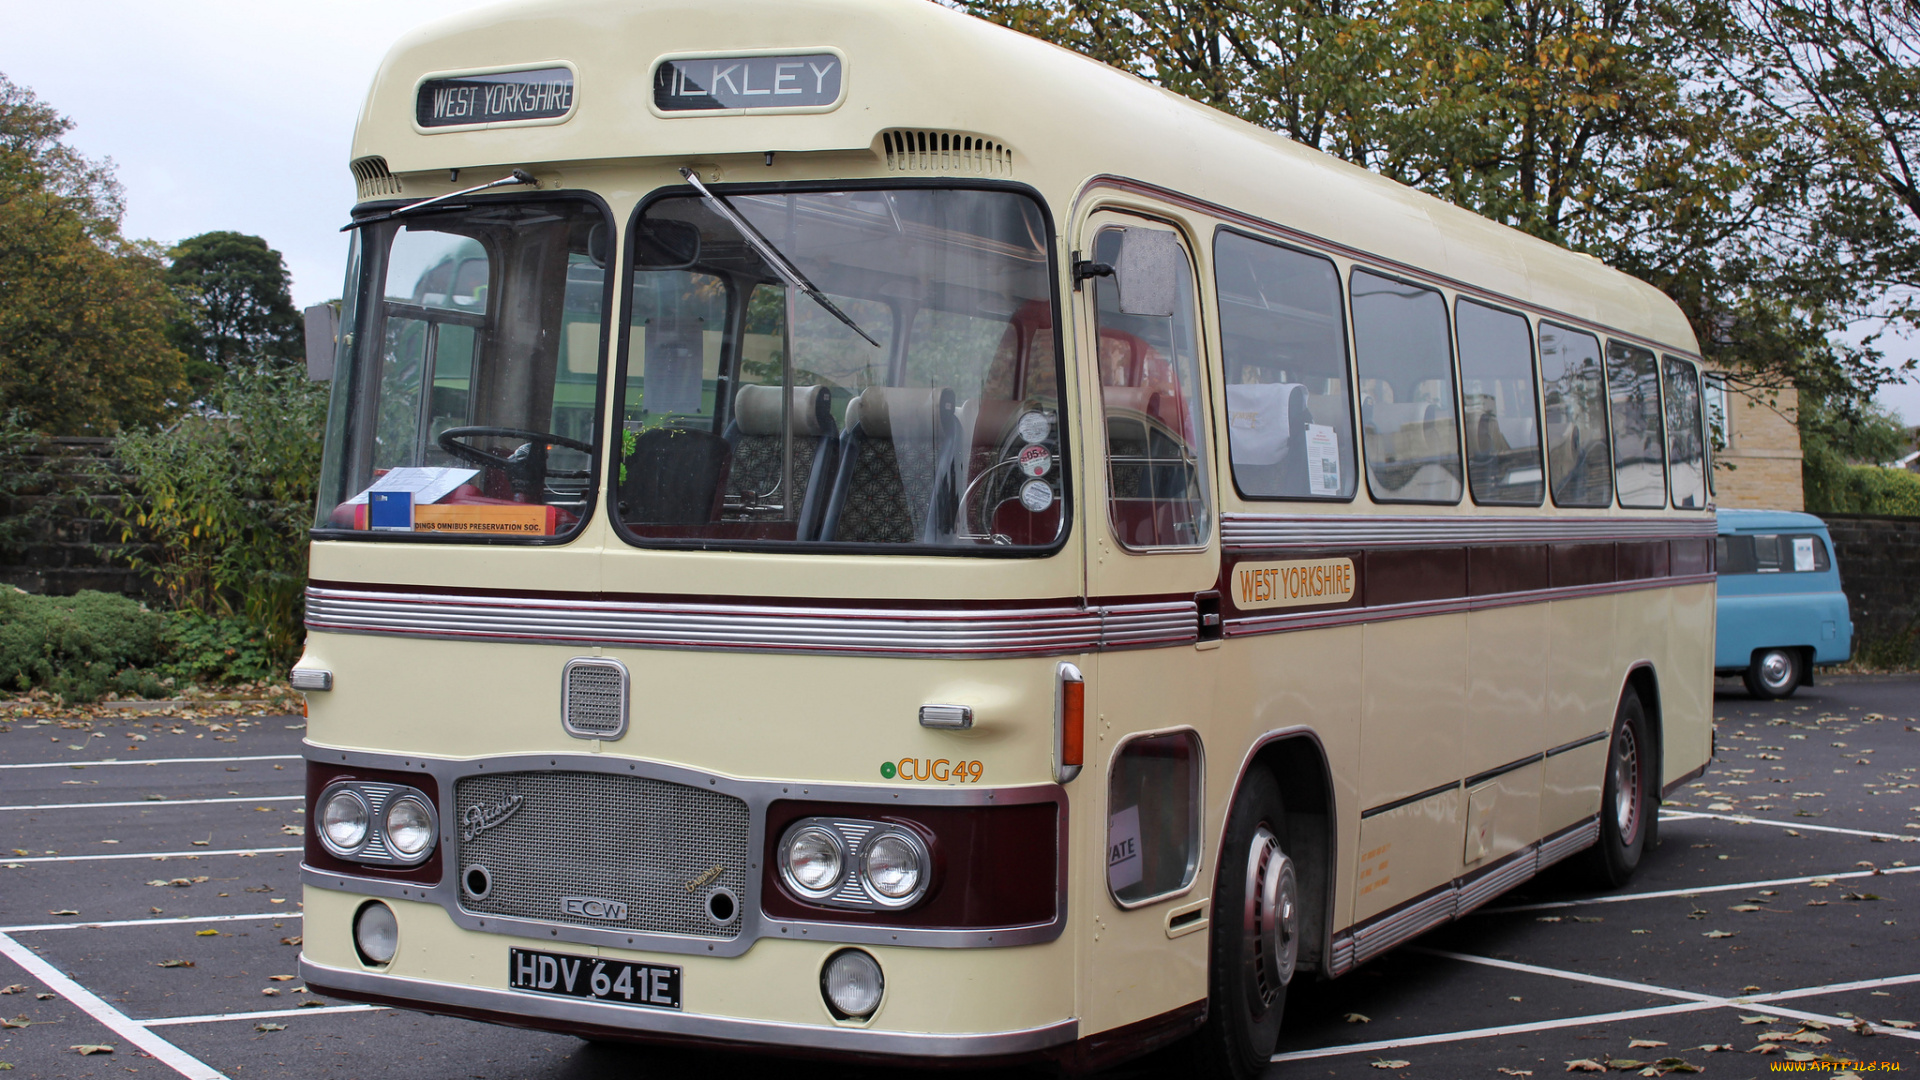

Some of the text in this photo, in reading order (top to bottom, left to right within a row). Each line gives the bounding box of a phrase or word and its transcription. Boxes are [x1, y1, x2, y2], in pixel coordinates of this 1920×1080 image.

[671, 61, 835, 96] ILKLEY
[434, 80, 573, 118] WEST YORKSHIRE
[437, 522, 468, 531] OMNIBUS
[469, 523, 522, 531] PRESERVATION
[1240, 564, 1350, 602] WEST YORKSHIRE
[566, 899, 621, 919] ECW
[516, 952, 672, 1004] HDV 641E
